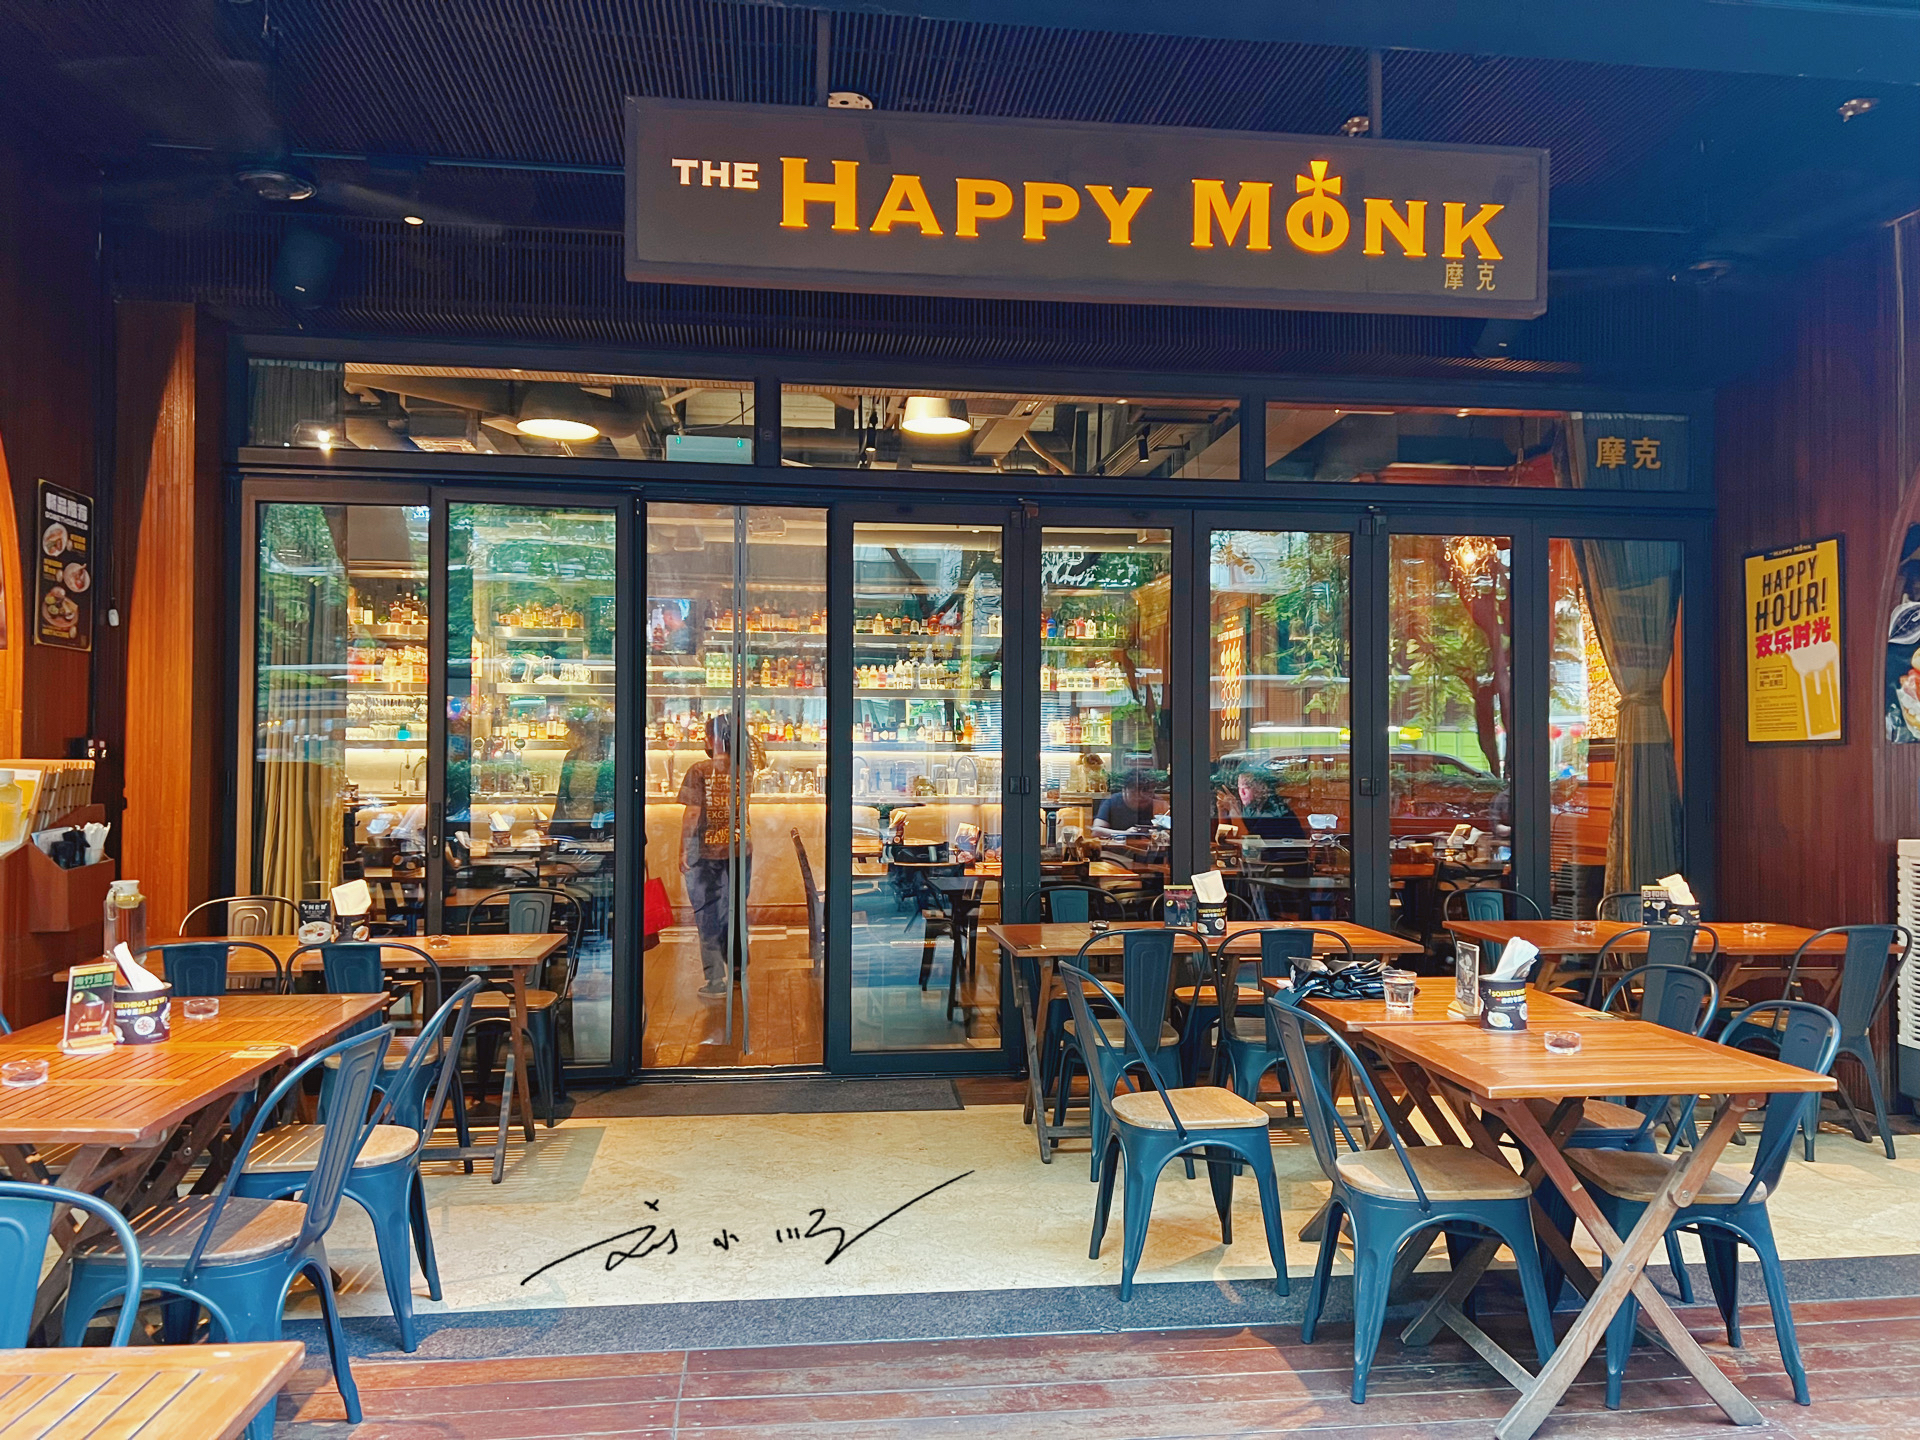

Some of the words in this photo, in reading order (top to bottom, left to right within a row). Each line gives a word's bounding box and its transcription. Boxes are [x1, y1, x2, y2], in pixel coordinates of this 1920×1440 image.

[671, 157, 760, 190] THE
[779, 156, 1153, 245] HAPPY
[1190, 159, 1505, 261] MONK
[1443, 261, 1496, 292] 摩克
[1595, 435, 1662, 470] 摩克
[1762, 554, 1818, 598] HAPPY
[1756, 577, 1827, 633] HOUR!
[1755, 616, 1832, 660] 欢乐时光
[705, 779, 713, 807] STAFF
